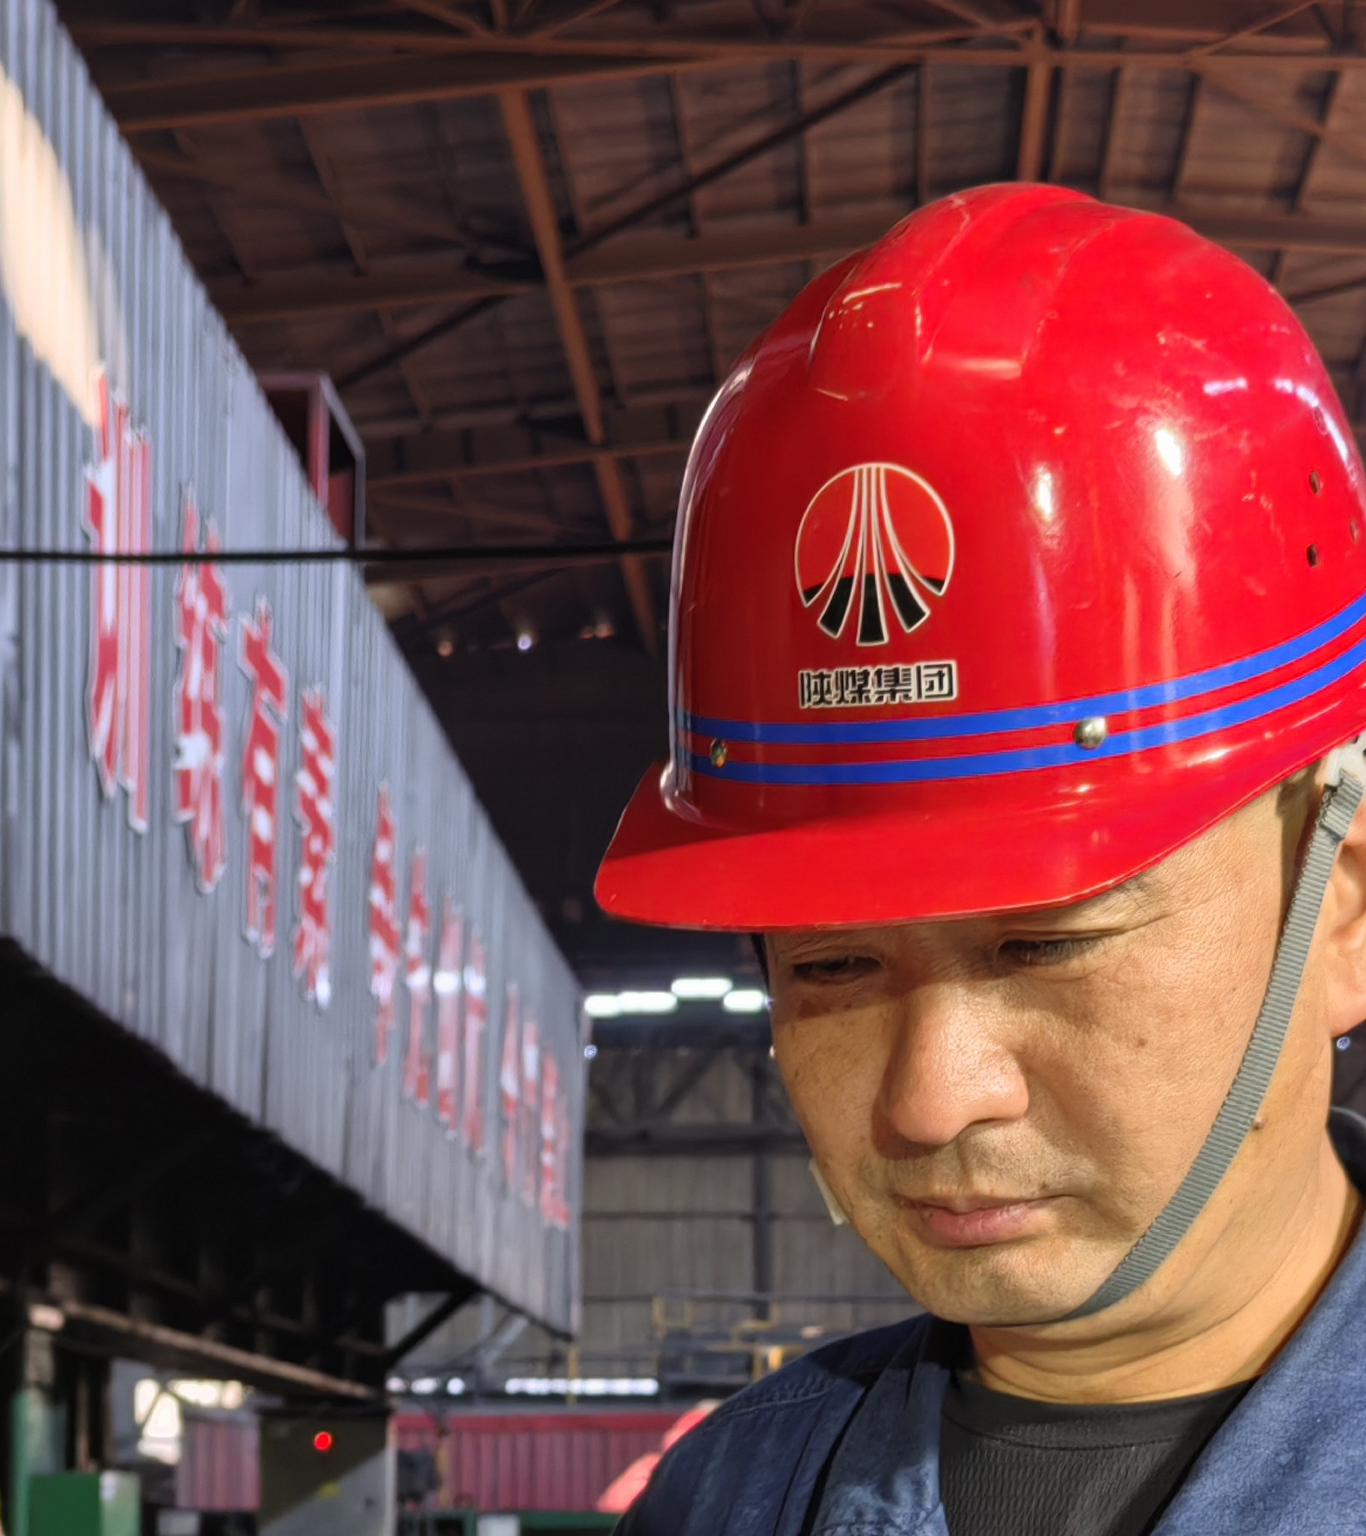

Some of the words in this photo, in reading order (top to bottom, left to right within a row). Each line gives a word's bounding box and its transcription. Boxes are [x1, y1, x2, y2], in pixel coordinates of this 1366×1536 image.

[85, 364, 337, 1016] 训练有素
[798, 660, 957, 708] 陕煤集团
